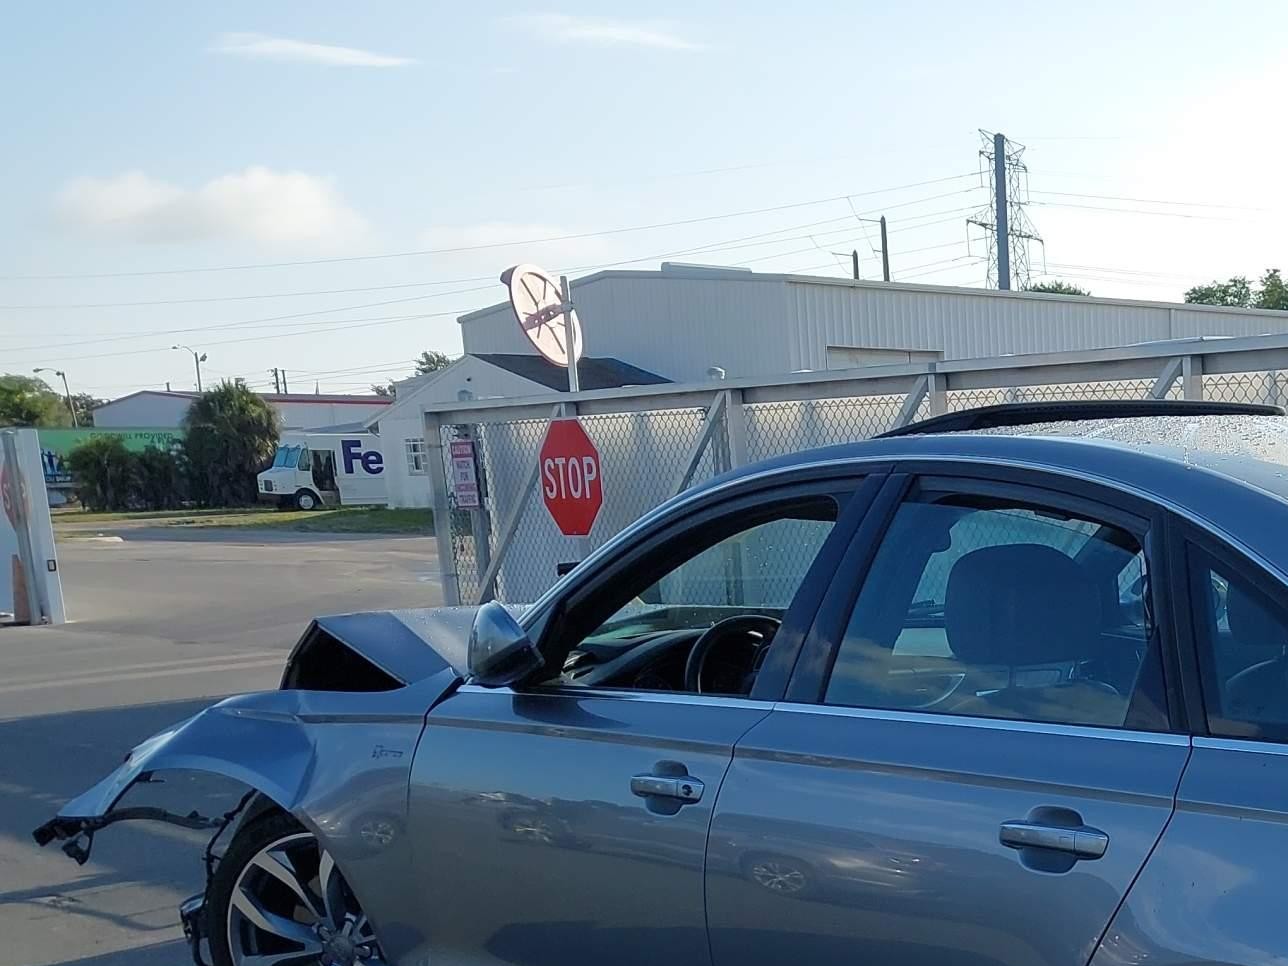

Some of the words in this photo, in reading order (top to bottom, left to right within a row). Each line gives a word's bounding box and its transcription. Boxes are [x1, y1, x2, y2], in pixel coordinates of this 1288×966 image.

[135, 432, 174, 441] PROVIDED
[341, 440, 384, 474] Fe
[544, 456, 597, 499] STOP
